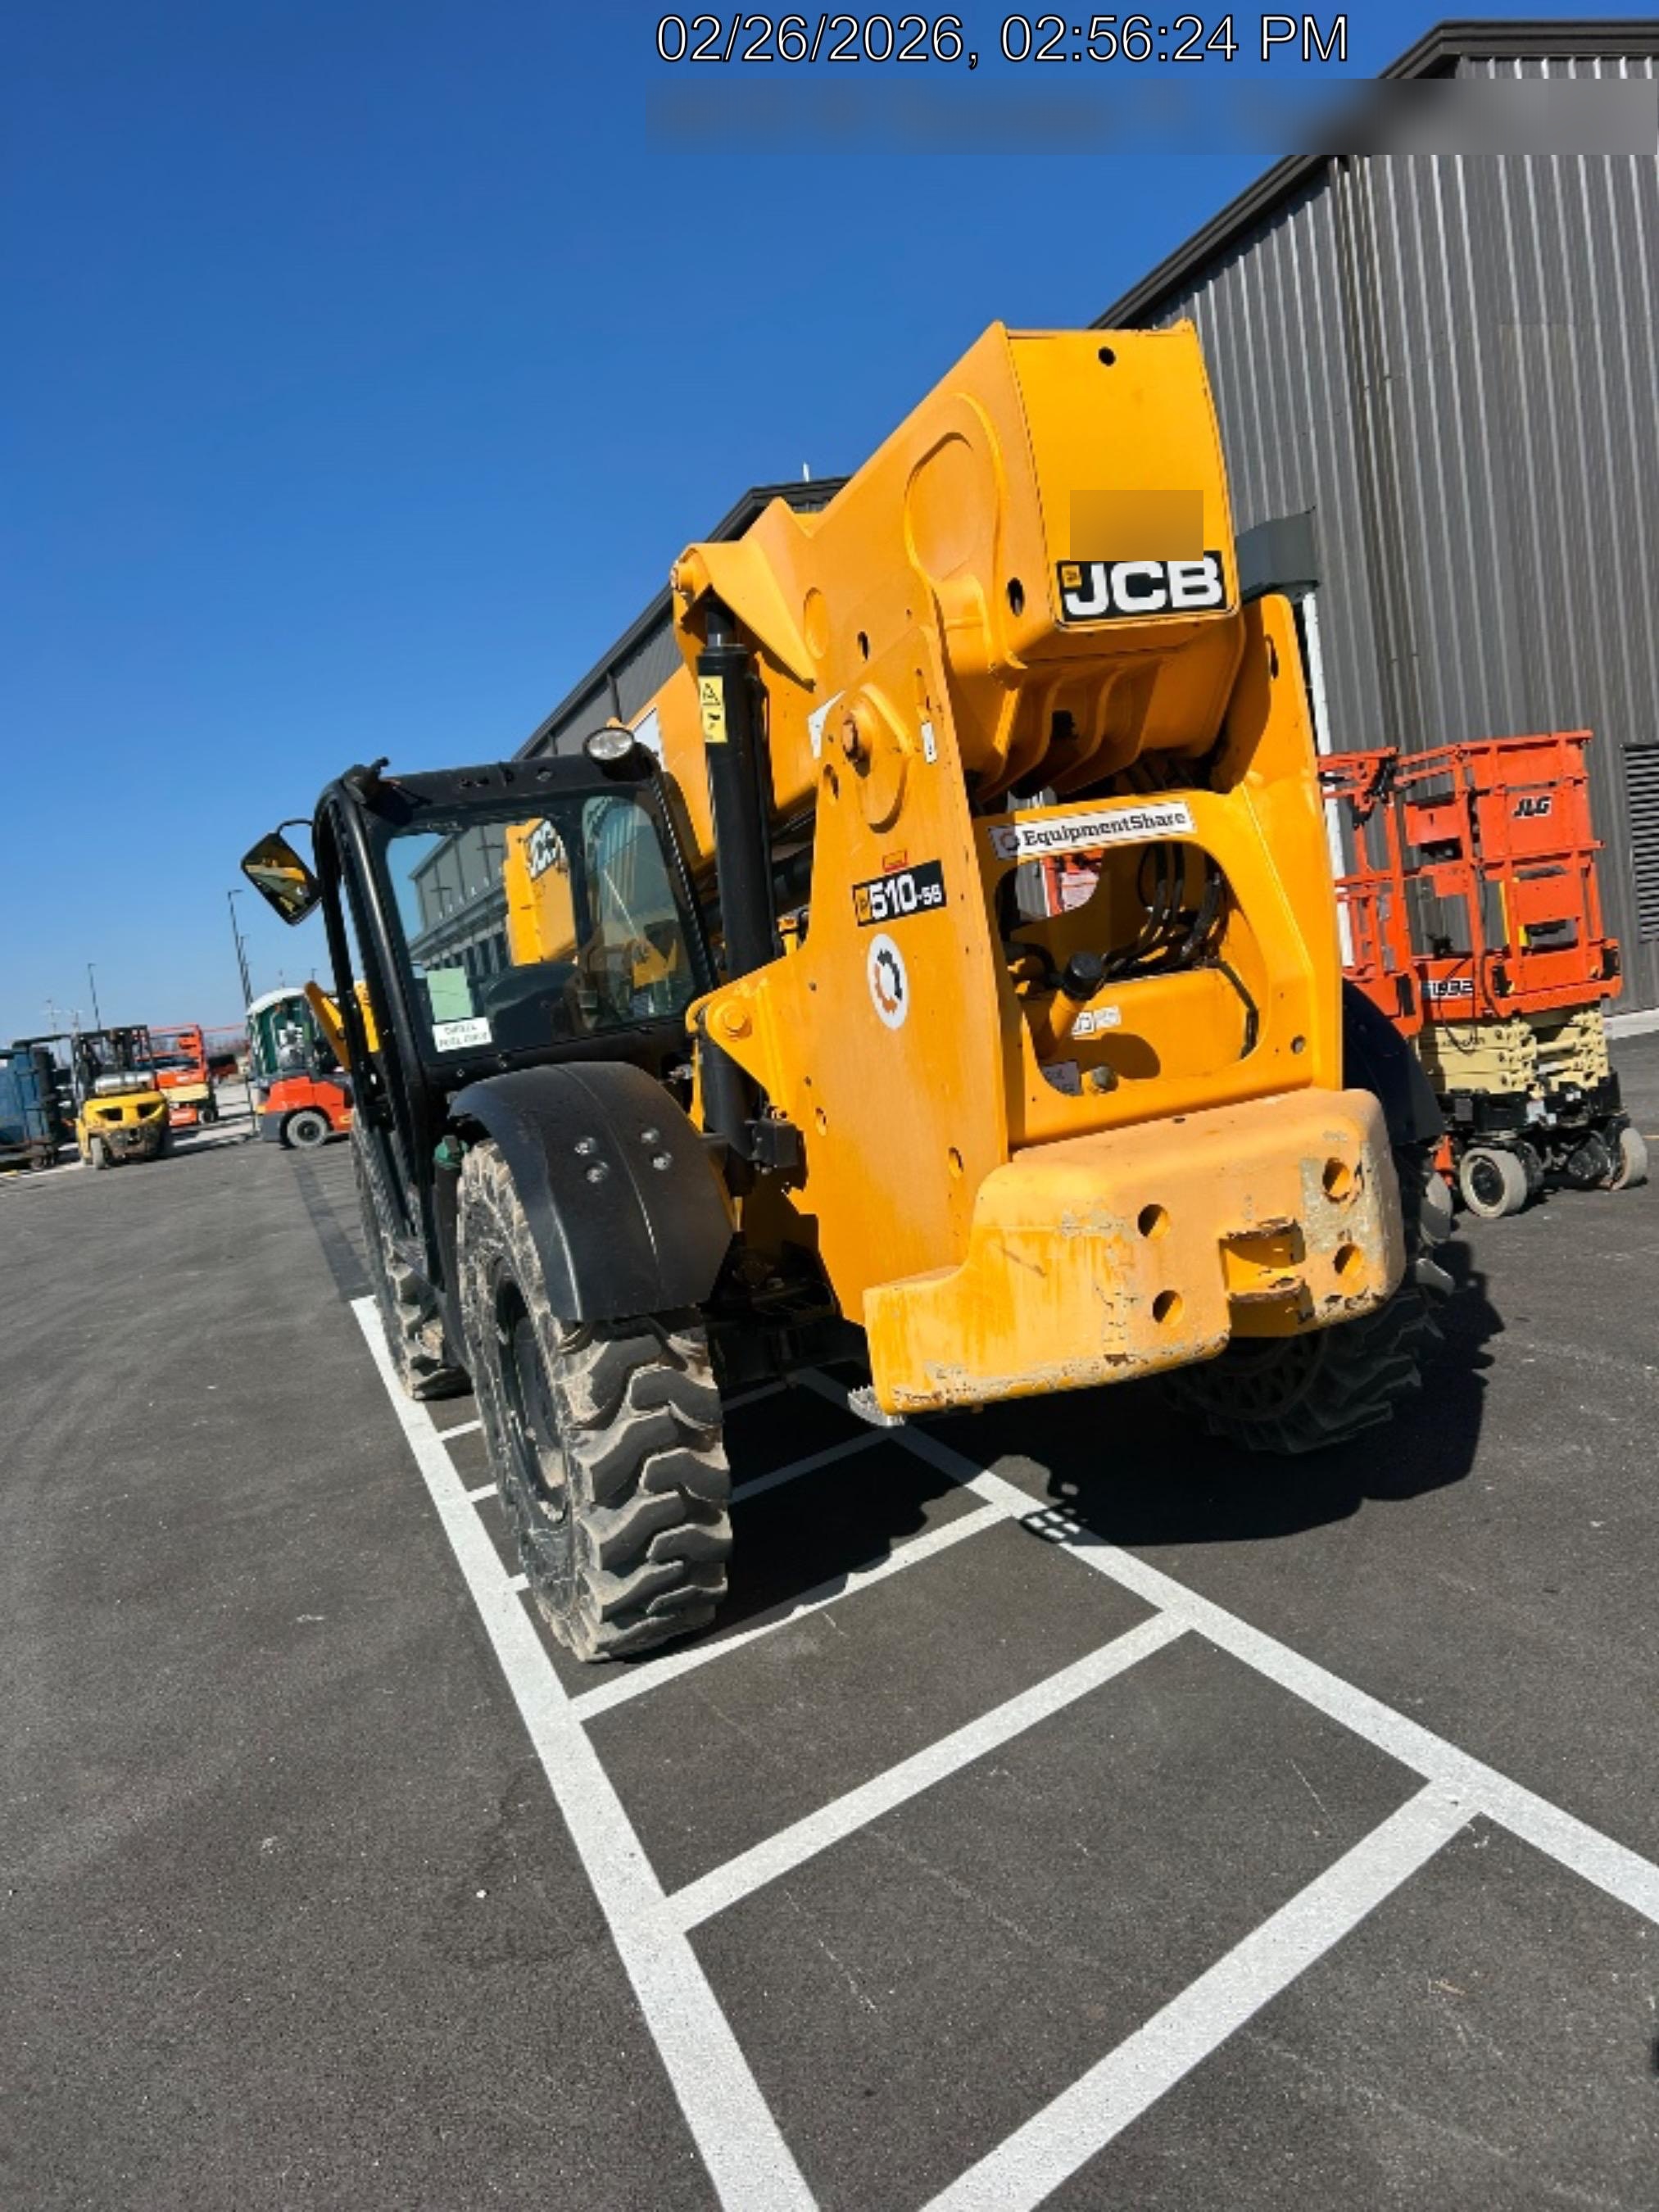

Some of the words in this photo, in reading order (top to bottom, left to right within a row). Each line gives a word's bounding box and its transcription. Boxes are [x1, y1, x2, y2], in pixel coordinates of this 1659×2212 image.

[1064, 556, 1222, 615] JCB
[1514, 796, 1552, 818] JLG
[1022, 813, 1186, 847] EquipmentShare
